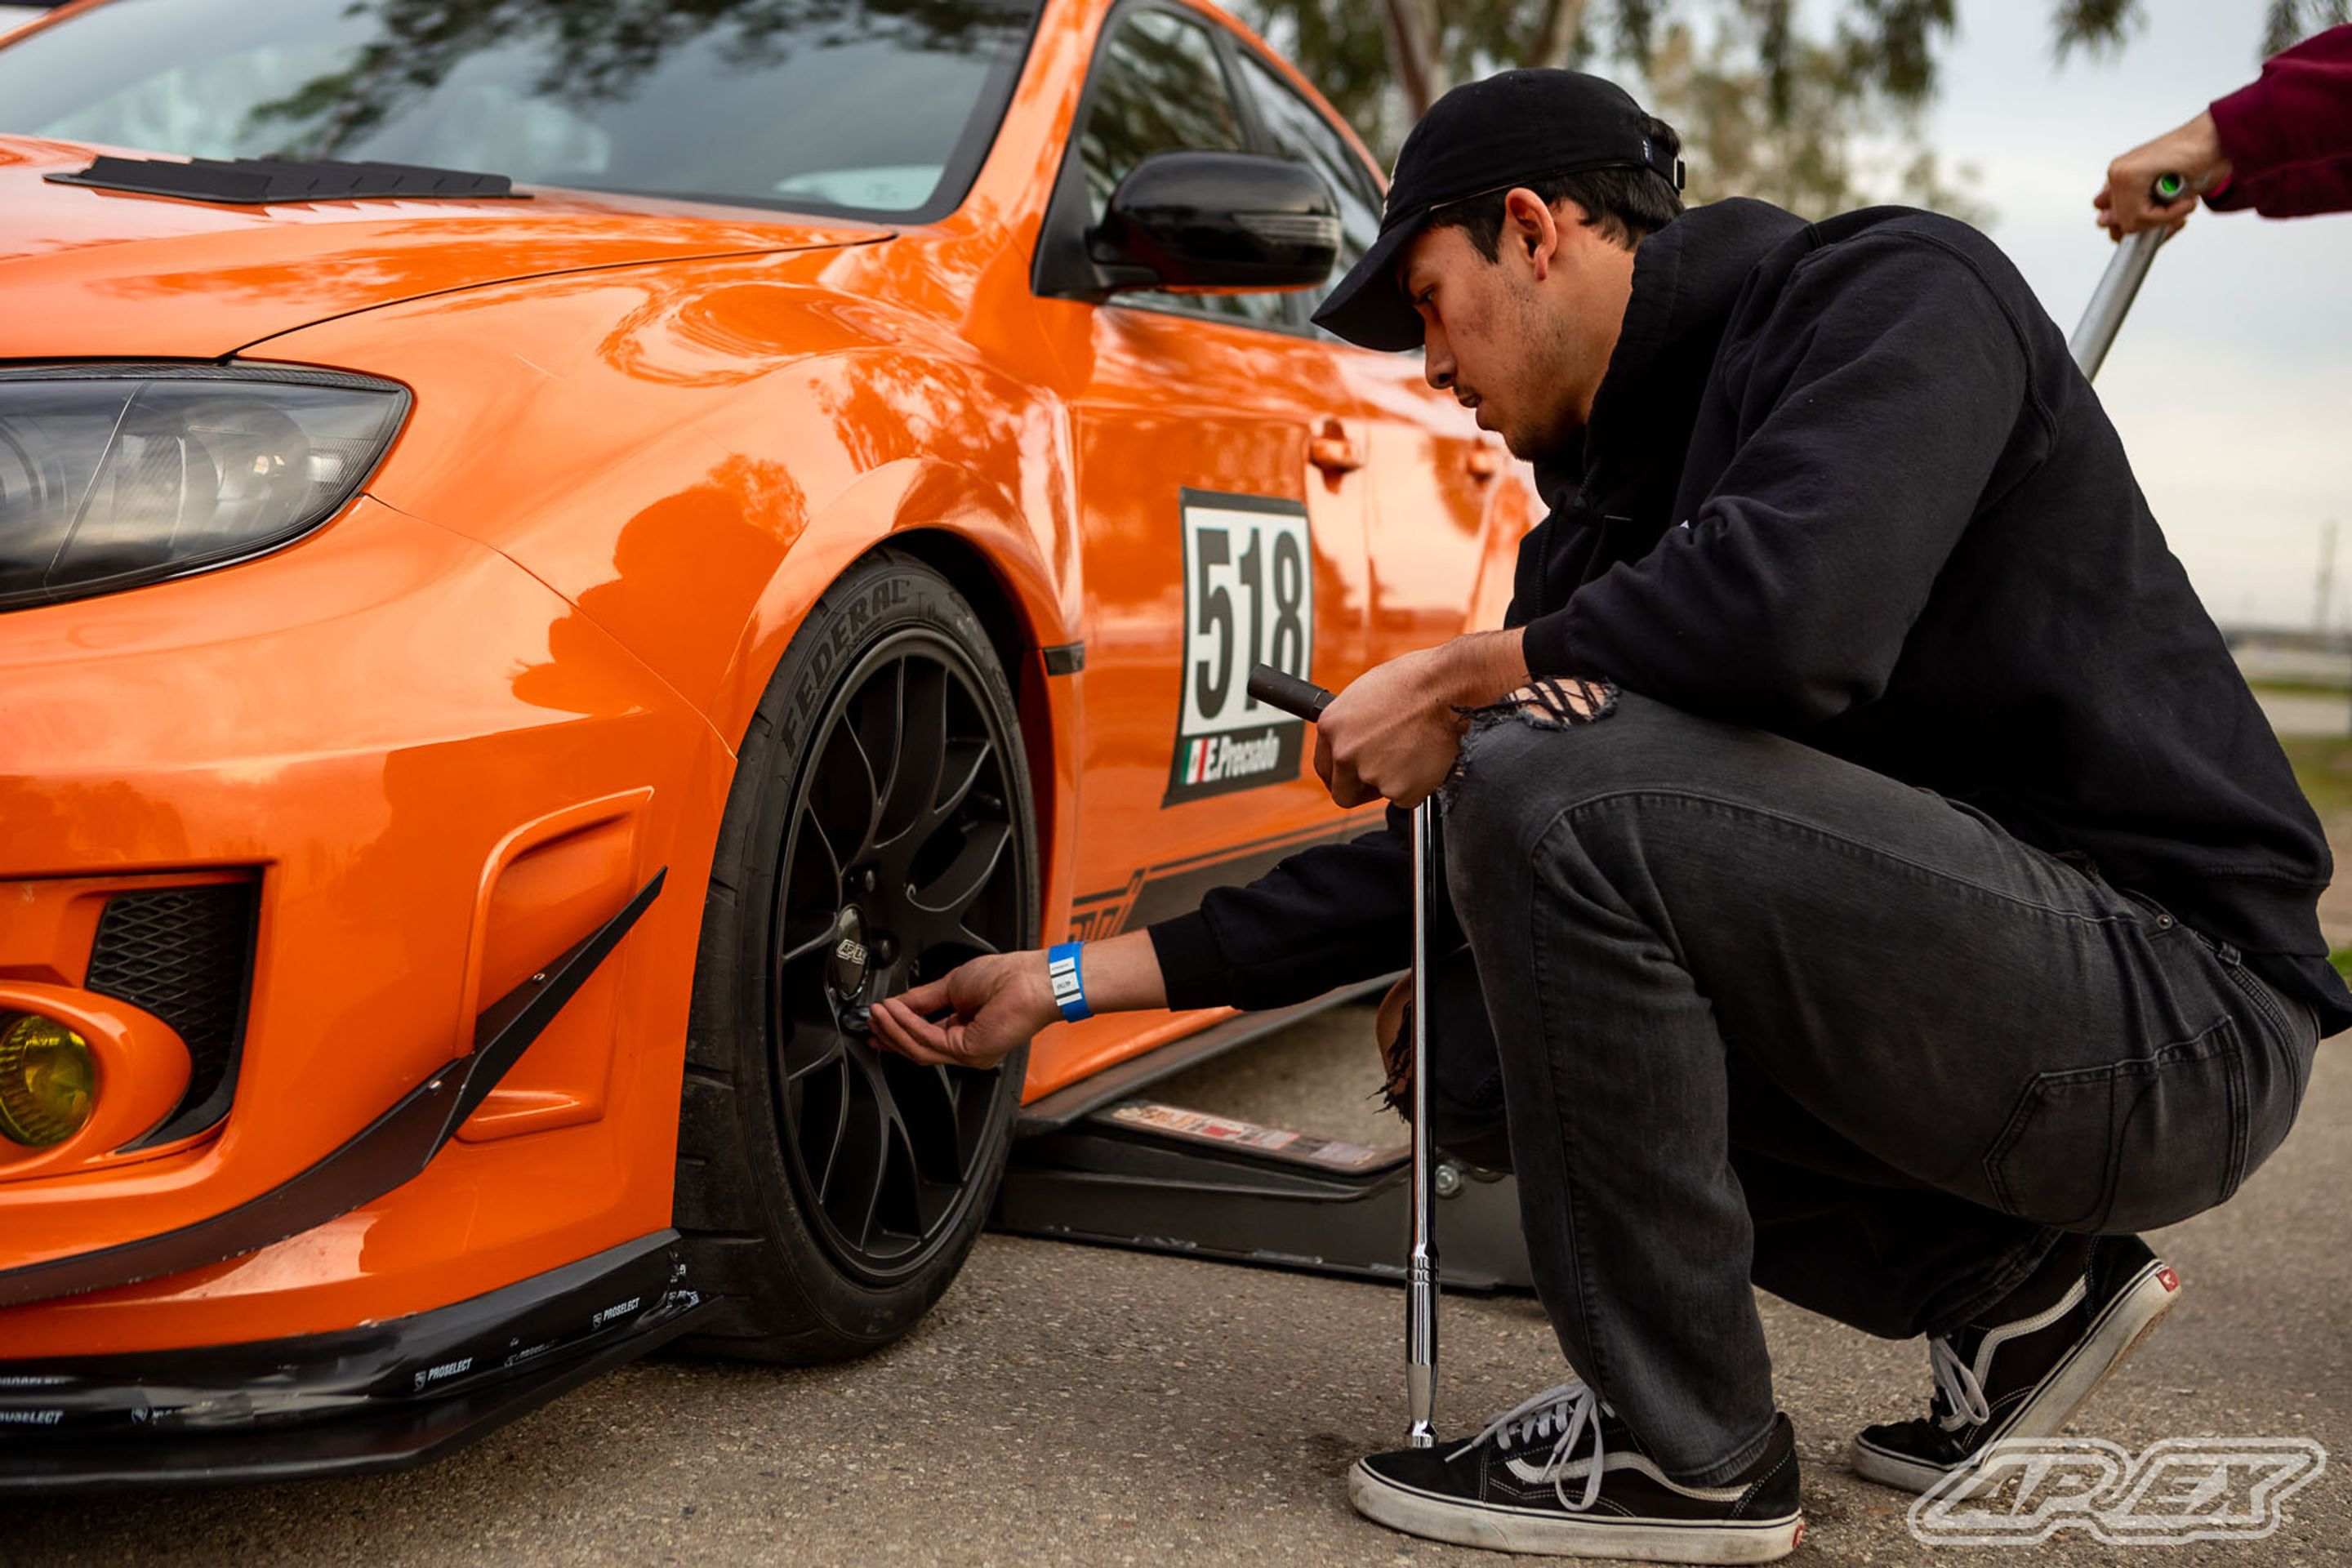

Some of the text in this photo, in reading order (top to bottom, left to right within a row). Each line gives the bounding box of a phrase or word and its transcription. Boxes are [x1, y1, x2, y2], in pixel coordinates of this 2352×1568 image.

[780, 578, 911, 758] FEDERAL
[1195, 527, 1304, 720] 518
[604, 1297, 640, 1321] PROSELECT
[428, 1357, 474, 1382] PROSELECT
